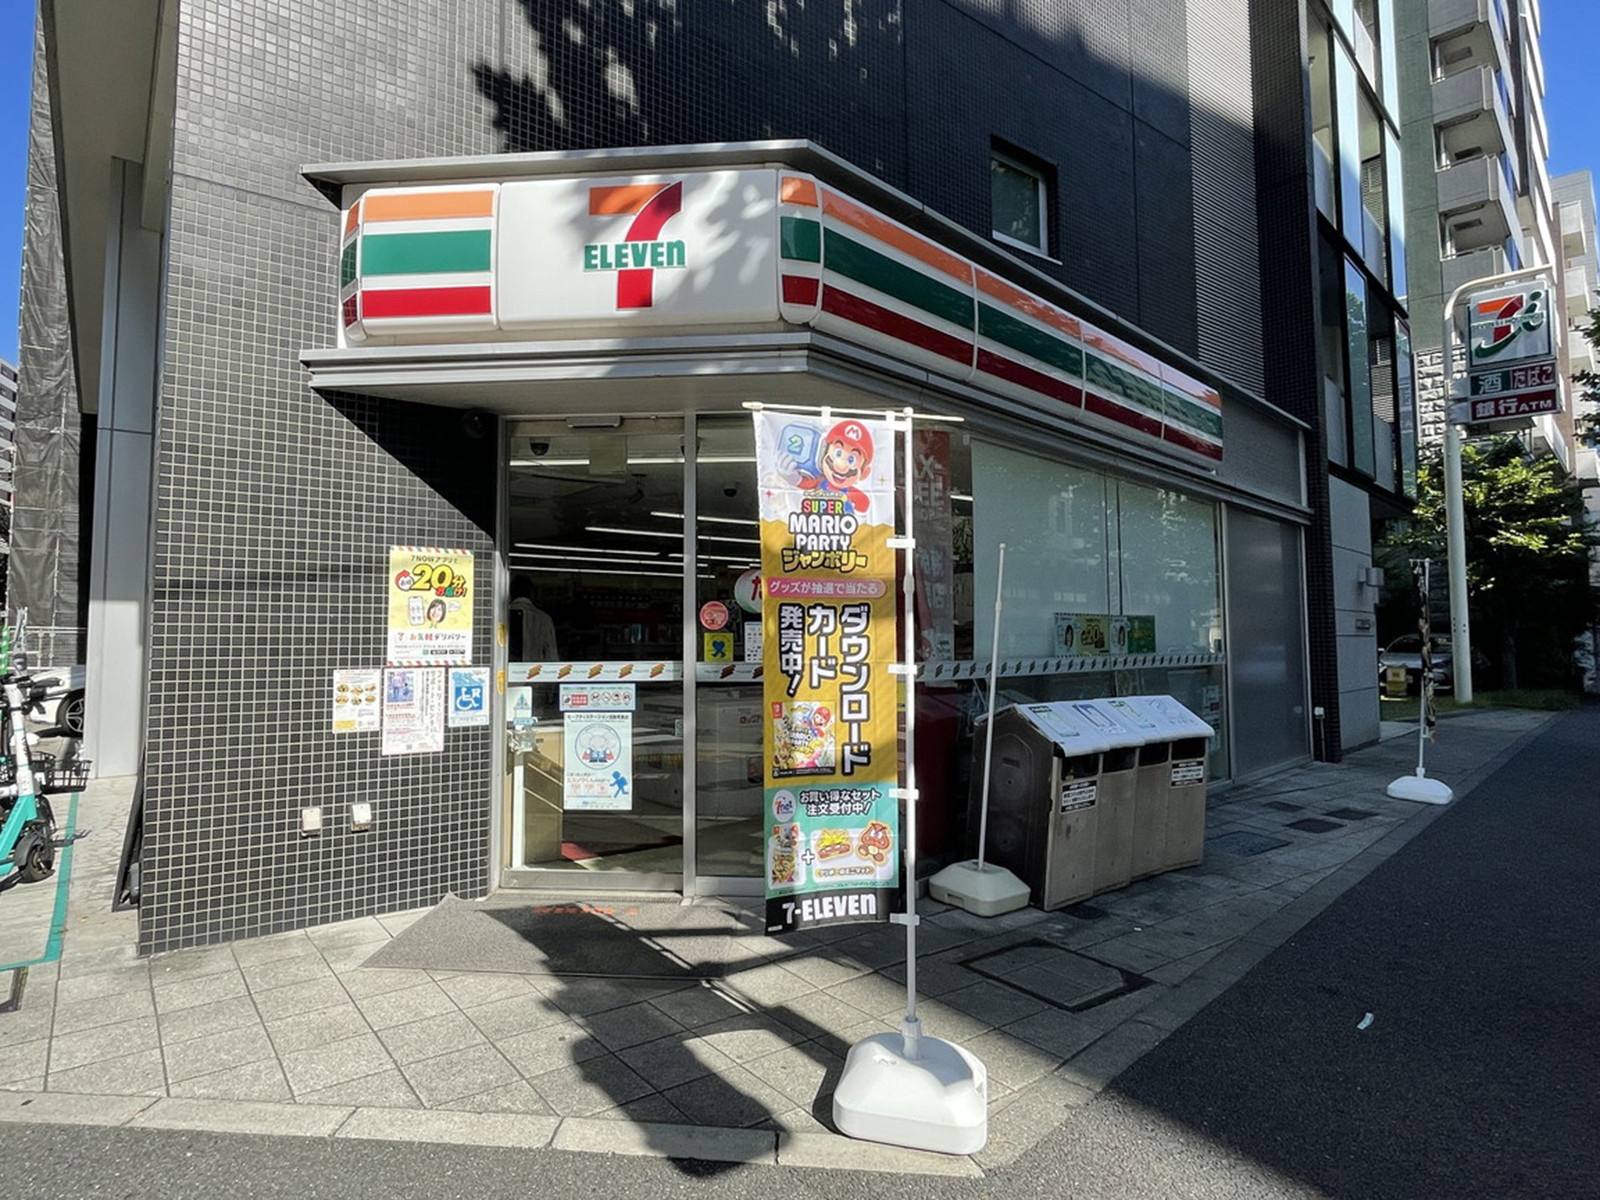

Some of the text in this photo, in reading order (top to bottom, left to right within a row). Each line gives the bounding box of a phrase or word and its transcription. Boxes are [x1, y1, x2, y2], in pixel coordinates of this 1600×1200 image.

[589, 180, 683, 309] 7
[1479, 374, 1502, 394] 酒
[1513, 365, 1553, 389] たばこ
[788, 434, 804, 455] 2
[802, 499, 844, 514] SUPER
[789, 513, 858, 534] MARIO
[795, 534, 851, 550] PARTY
[782, 549, 868, 572] ジャンボリー
[770, 579, 878, 595] グッズが抽選で当たる
[808, 603, 837, 688] カード
[840, 603, 871, 776] ダウンロード
[800, 788, 882, 804] お買い得なセット
